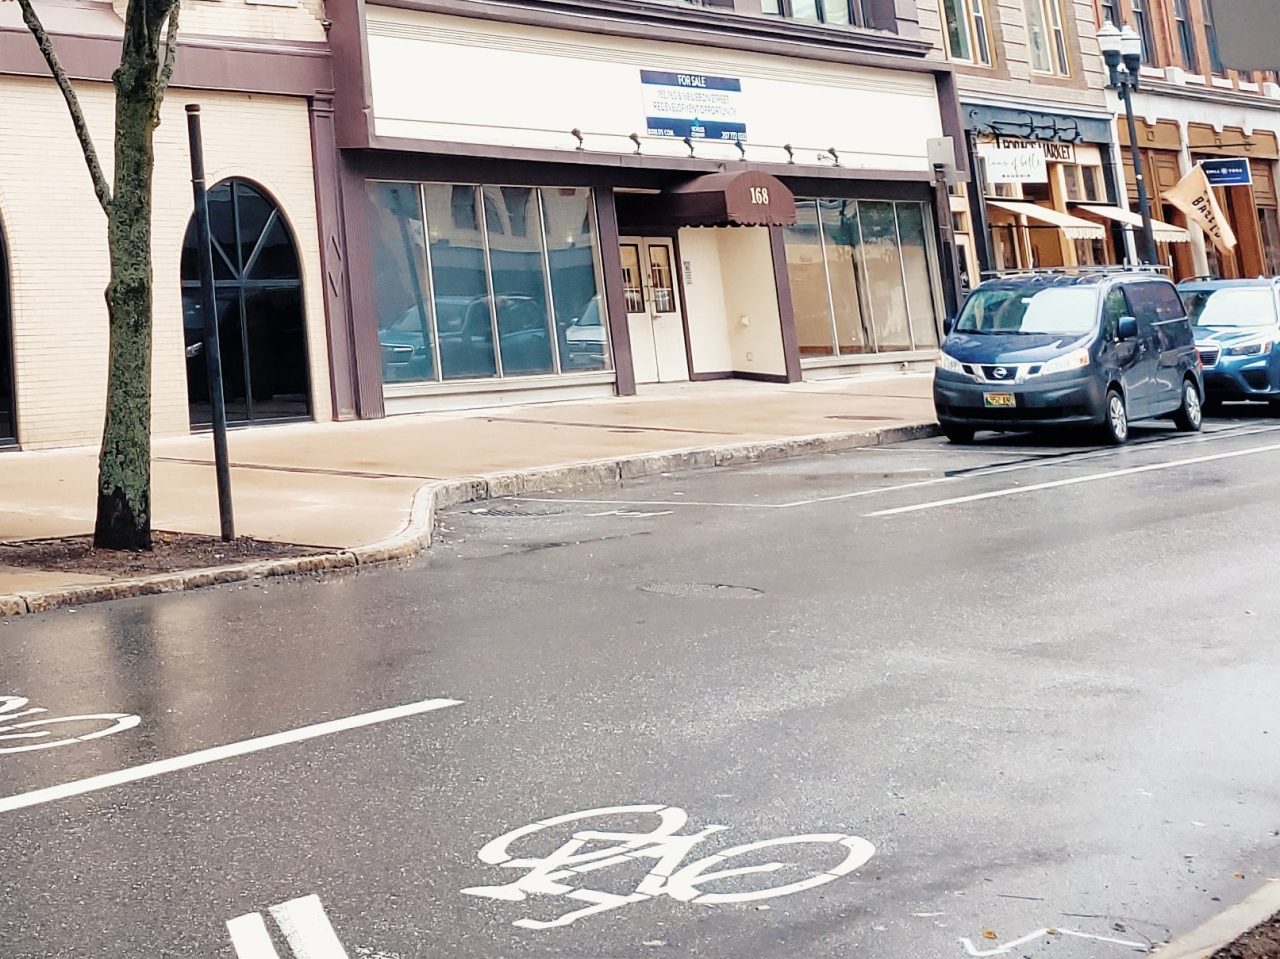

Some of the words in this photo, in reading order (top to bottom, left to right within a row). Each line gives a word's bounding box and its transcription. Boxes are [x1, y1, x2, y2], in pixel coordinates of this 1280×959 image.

[677, 74, 692, 86] FOR
[691, 76, 706, 88] SALE
[1041, 142, 1070, 159] MARKET
[750, 187, 769, 204] 168
